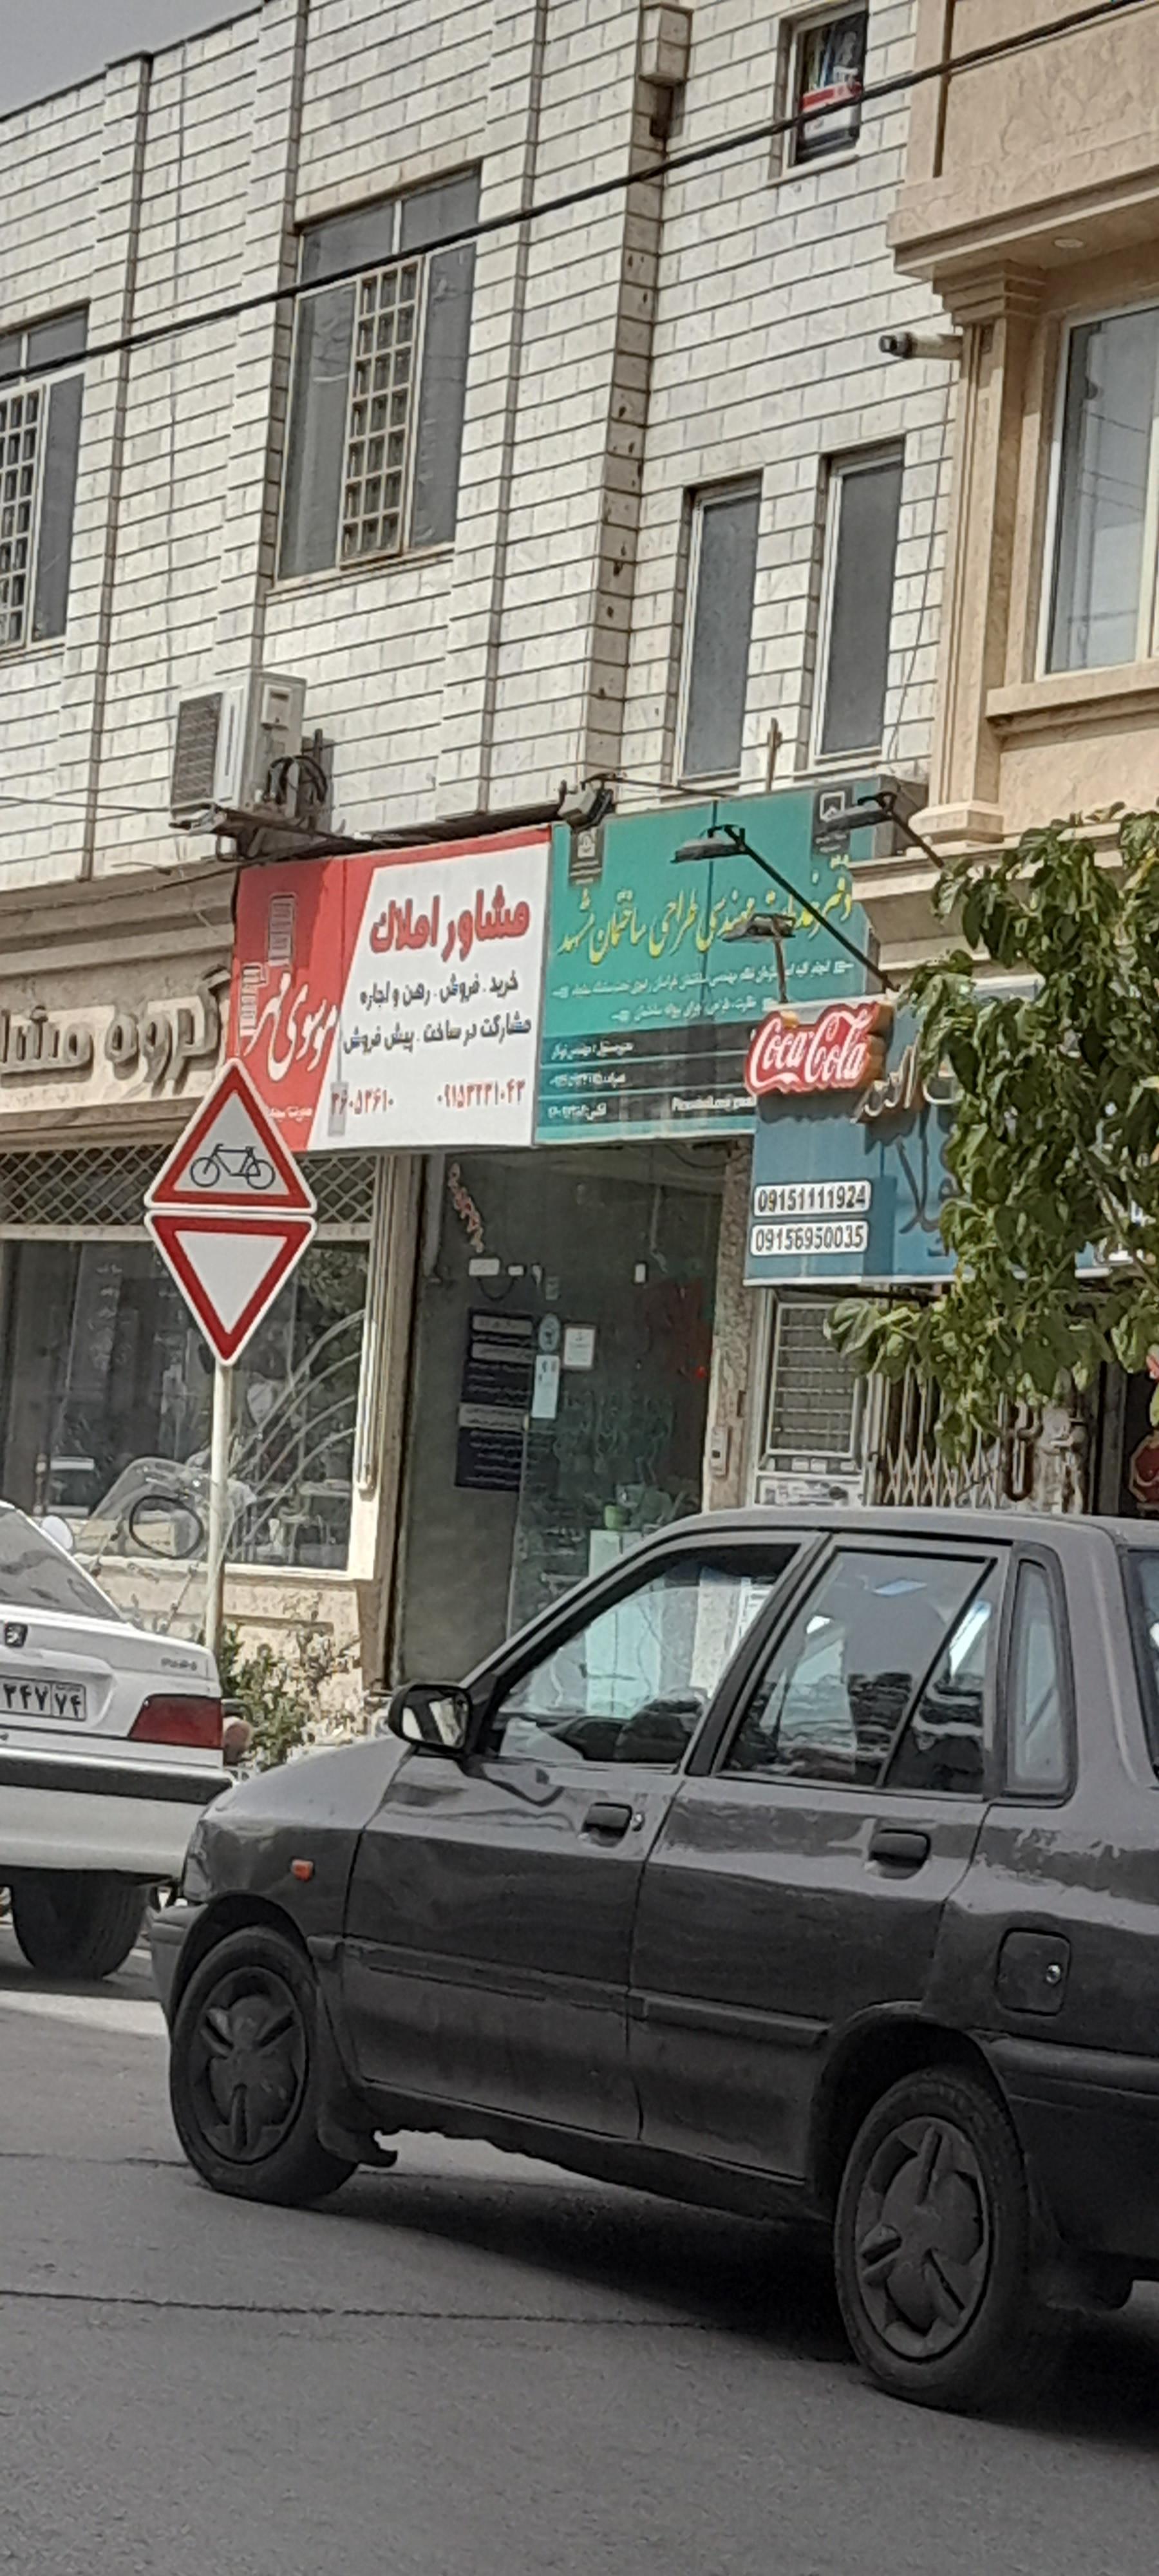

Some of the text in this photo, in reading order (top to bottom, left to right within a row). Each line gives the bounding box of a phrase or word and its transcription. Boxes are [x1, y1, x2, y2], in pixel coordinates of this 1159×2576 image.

[370, 884, 531, 962] مشاور املاک
[557, 887, 595, 955] مشهد
[589, 889, 646, 964] ساختمان
[360, 969, 519, 1011] خرید فروش رهن و اجاره
[0, 965, 231, 1083] گروه مشا
[343, 1010, 532, 1055] مشارکت در ساخت پیش فروش
[757, 1186, 866, 1212] 09151111924
[755, 1225, 864, 1252] 09156950035
